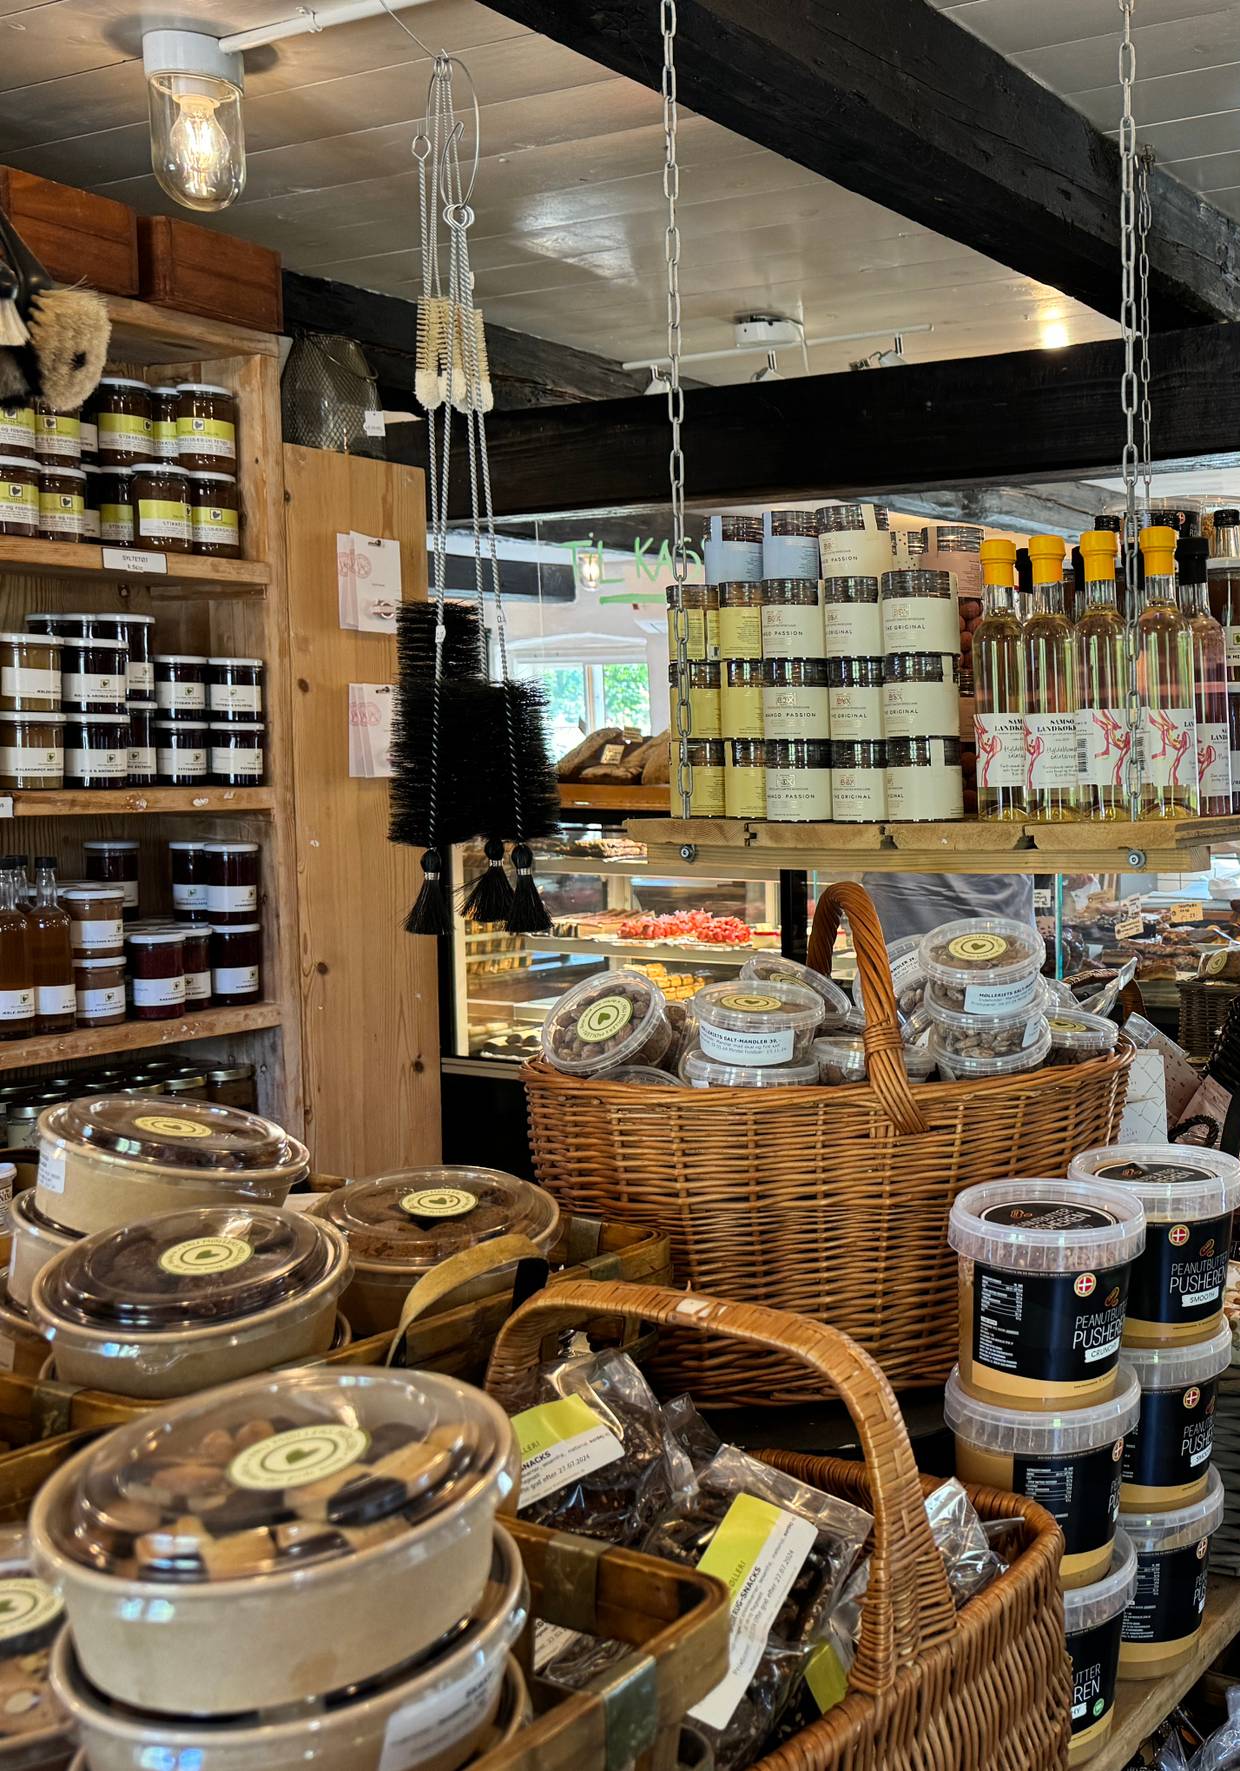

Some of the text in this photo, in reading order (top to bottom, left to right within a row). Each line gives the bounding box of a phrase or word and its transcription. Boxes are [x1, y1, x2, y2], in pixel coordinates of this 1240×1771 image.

[634, 536, 705, 582] KAS
[1189, 1291, 1215, 1304] SMOOTH
[1073, 1677, 1101, 1704] REN
